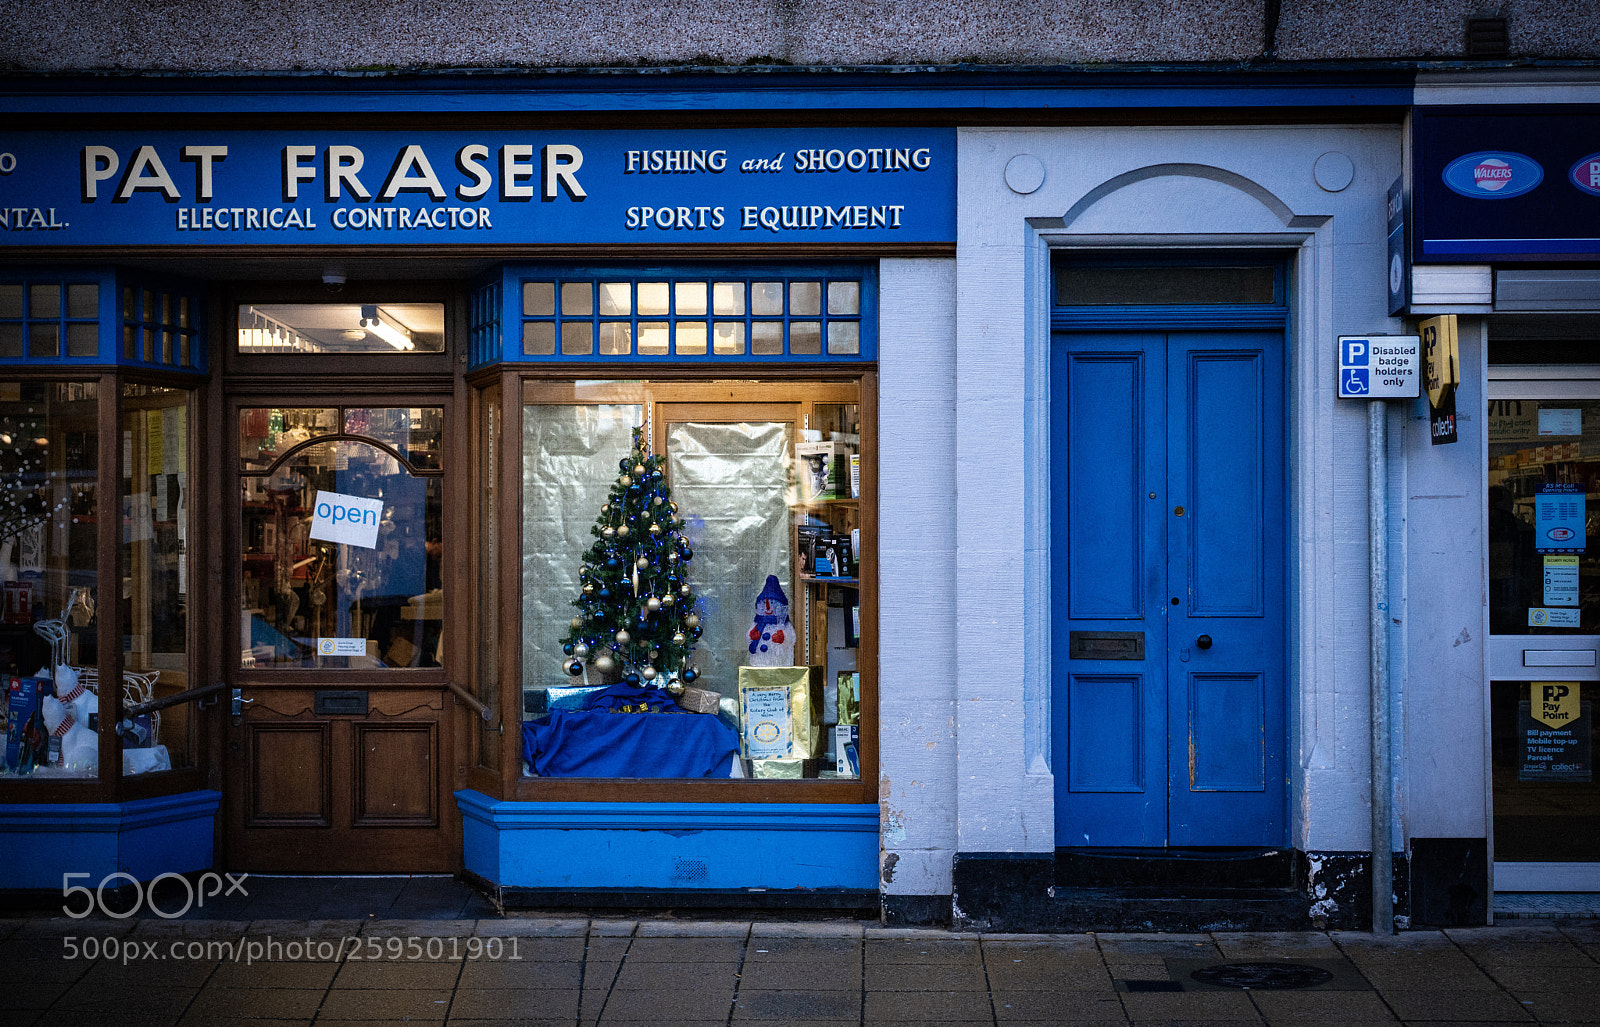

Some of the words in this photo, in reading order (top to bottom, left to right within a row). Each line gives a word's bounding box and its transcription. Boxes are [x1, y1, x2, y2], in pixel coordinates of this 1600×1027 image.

[624, 149, 728, 174] FISHING
[740, 152, 784, 173] and
[794, 148, 932, 173] SHOOTING
[80, 145, 228, 203] PAT
[281, 144, 587, 203] FRASER
[1474, 167, 1512, 179] WALKERS
[176, 207, 317, 231] ELECTRICAL
[331, 207, 493, 231] CONTRACTOR
[625, 206, 725, 231] SPORTS
[740, 205, 906, 233] EQUIPMENT
[1349, 343, 1365, 364] P
[1373, 346, 1416, 355] Disabled
[1378, 357, 1409, 366] badge
[1375, 367, 1413, 375] holders
[1383, 378, 1404, 387] only
[318, 503, 376, 526] open
[1543, 703, 1560, 712] Pay
[1540, 730, 1572, 738] payment
[1553, 738, 1578, 746] top-up
